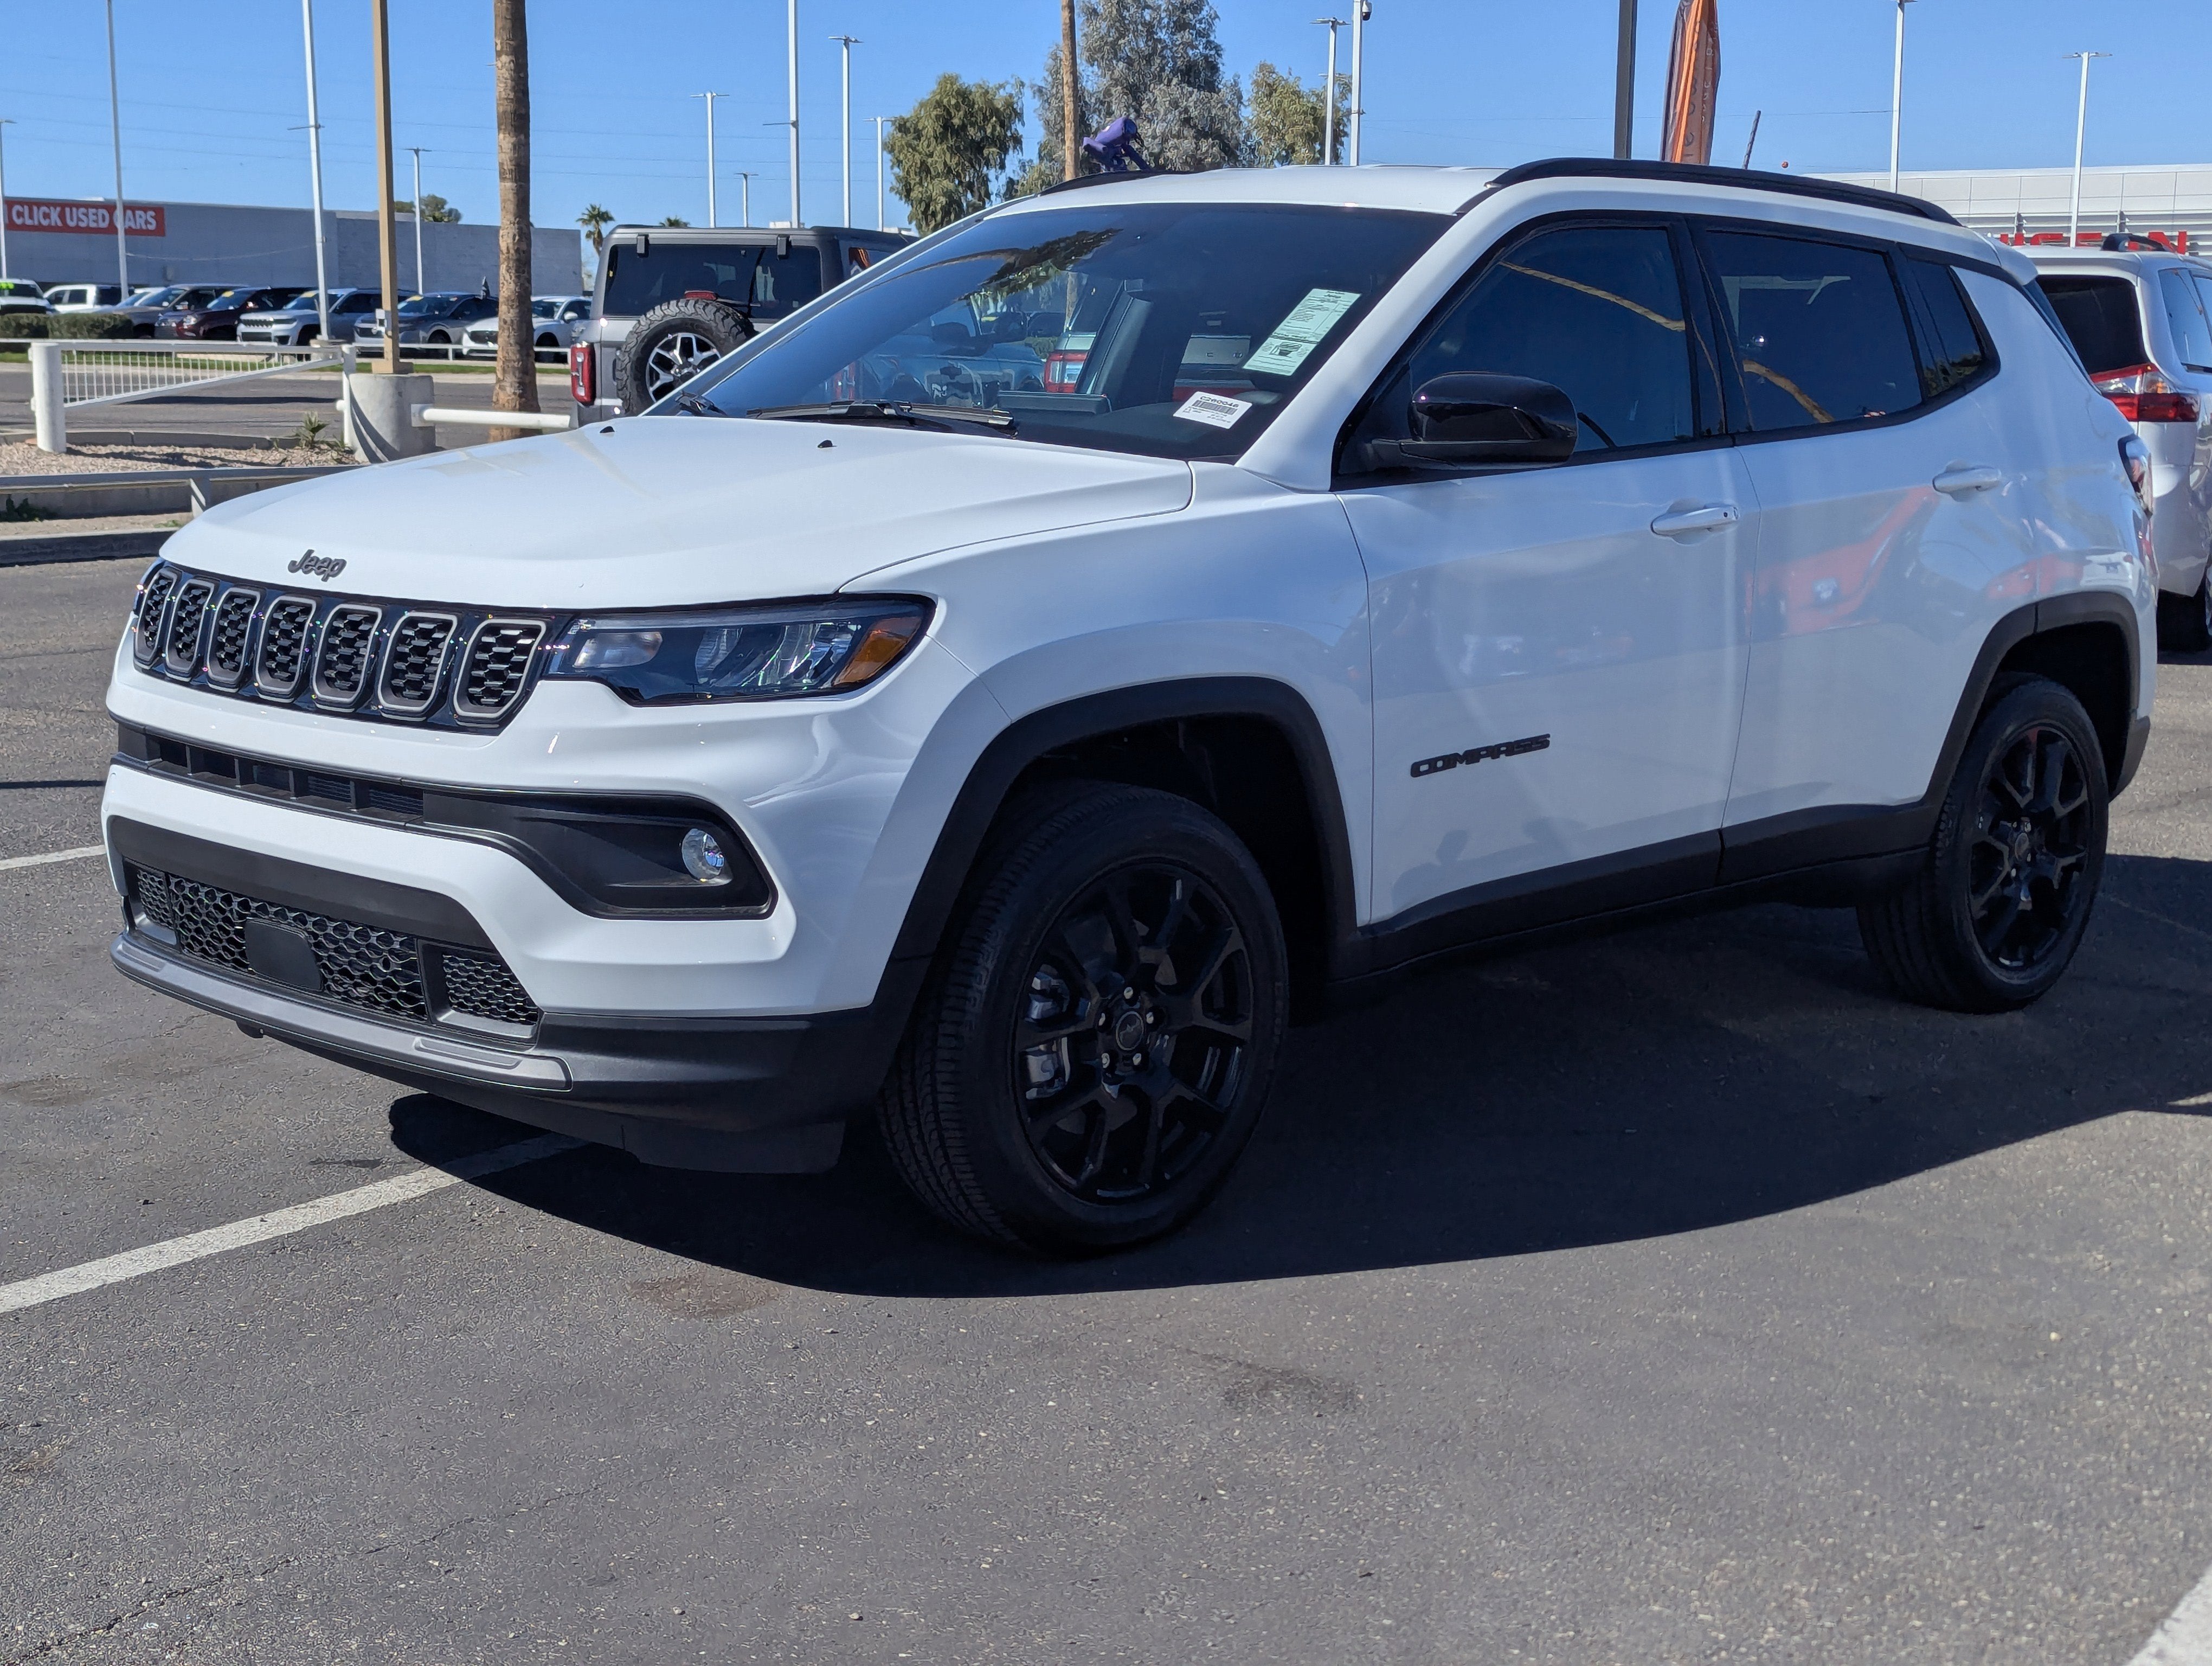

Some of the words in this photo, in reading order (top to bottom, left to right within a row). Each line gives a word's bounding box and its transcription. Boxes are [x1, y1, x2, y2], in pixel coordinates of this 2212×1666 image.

[12, 204, 62, 226] CLICK
[65, 207, 110, 228] USED
[287, 549, 347, 582] Jeep
[1410, 733, 1551, 778] COMPASS
